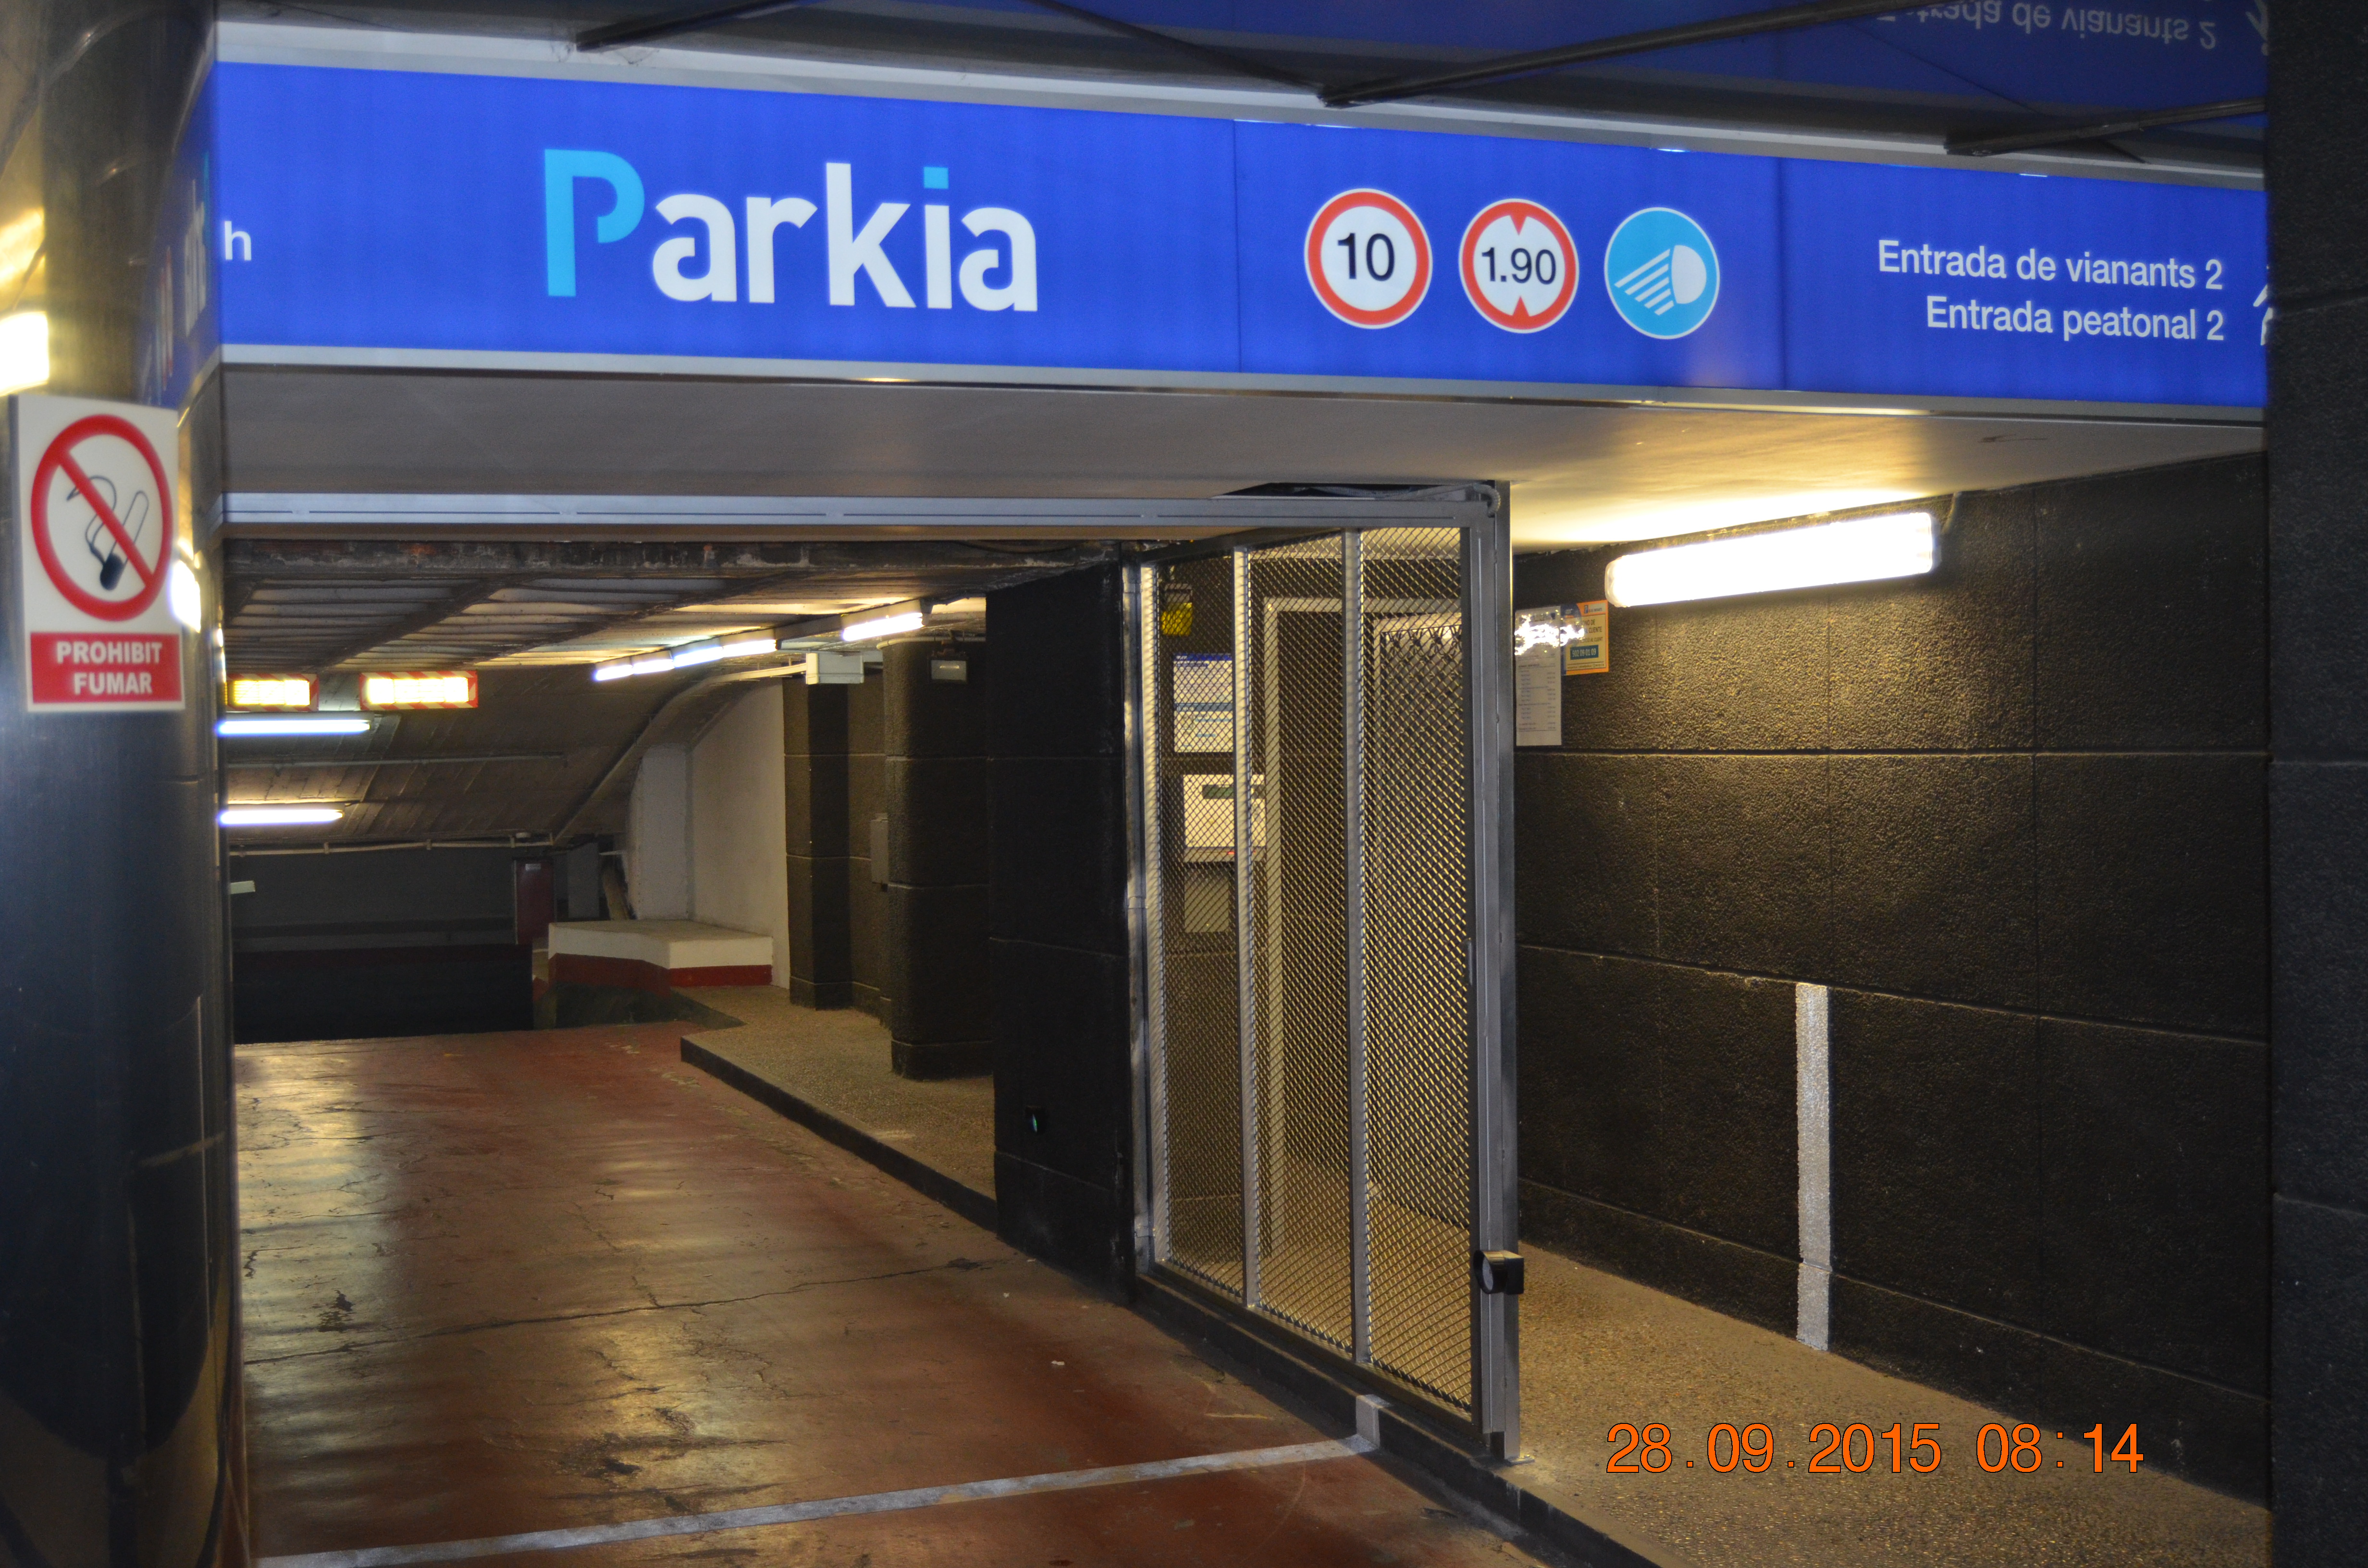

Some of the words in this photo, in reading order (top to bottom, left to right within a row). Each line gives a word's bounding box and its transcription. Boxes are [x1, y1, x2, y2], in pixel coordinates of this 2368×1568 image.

[544, 148, 1038, 312] Parkia
[1337, 233, 1395, 282] 10
[1481, 247, 1557, 285] 1.90
[1878, 239, 2007, 279] Entrada
[2016, 248, 2056, 281] de
[2066, 252, 2195, 288] vianants
[2206, 259, 2223, 290] 2
[1926, 295, 2053, 333] Entrada
[2063, 307, 2195, 342] peatonal
[2207, 310, 2224, 341] 2
[56, 641, 162, 664] PROHIBIT
[73, 672, 152, 695] FUMAR
